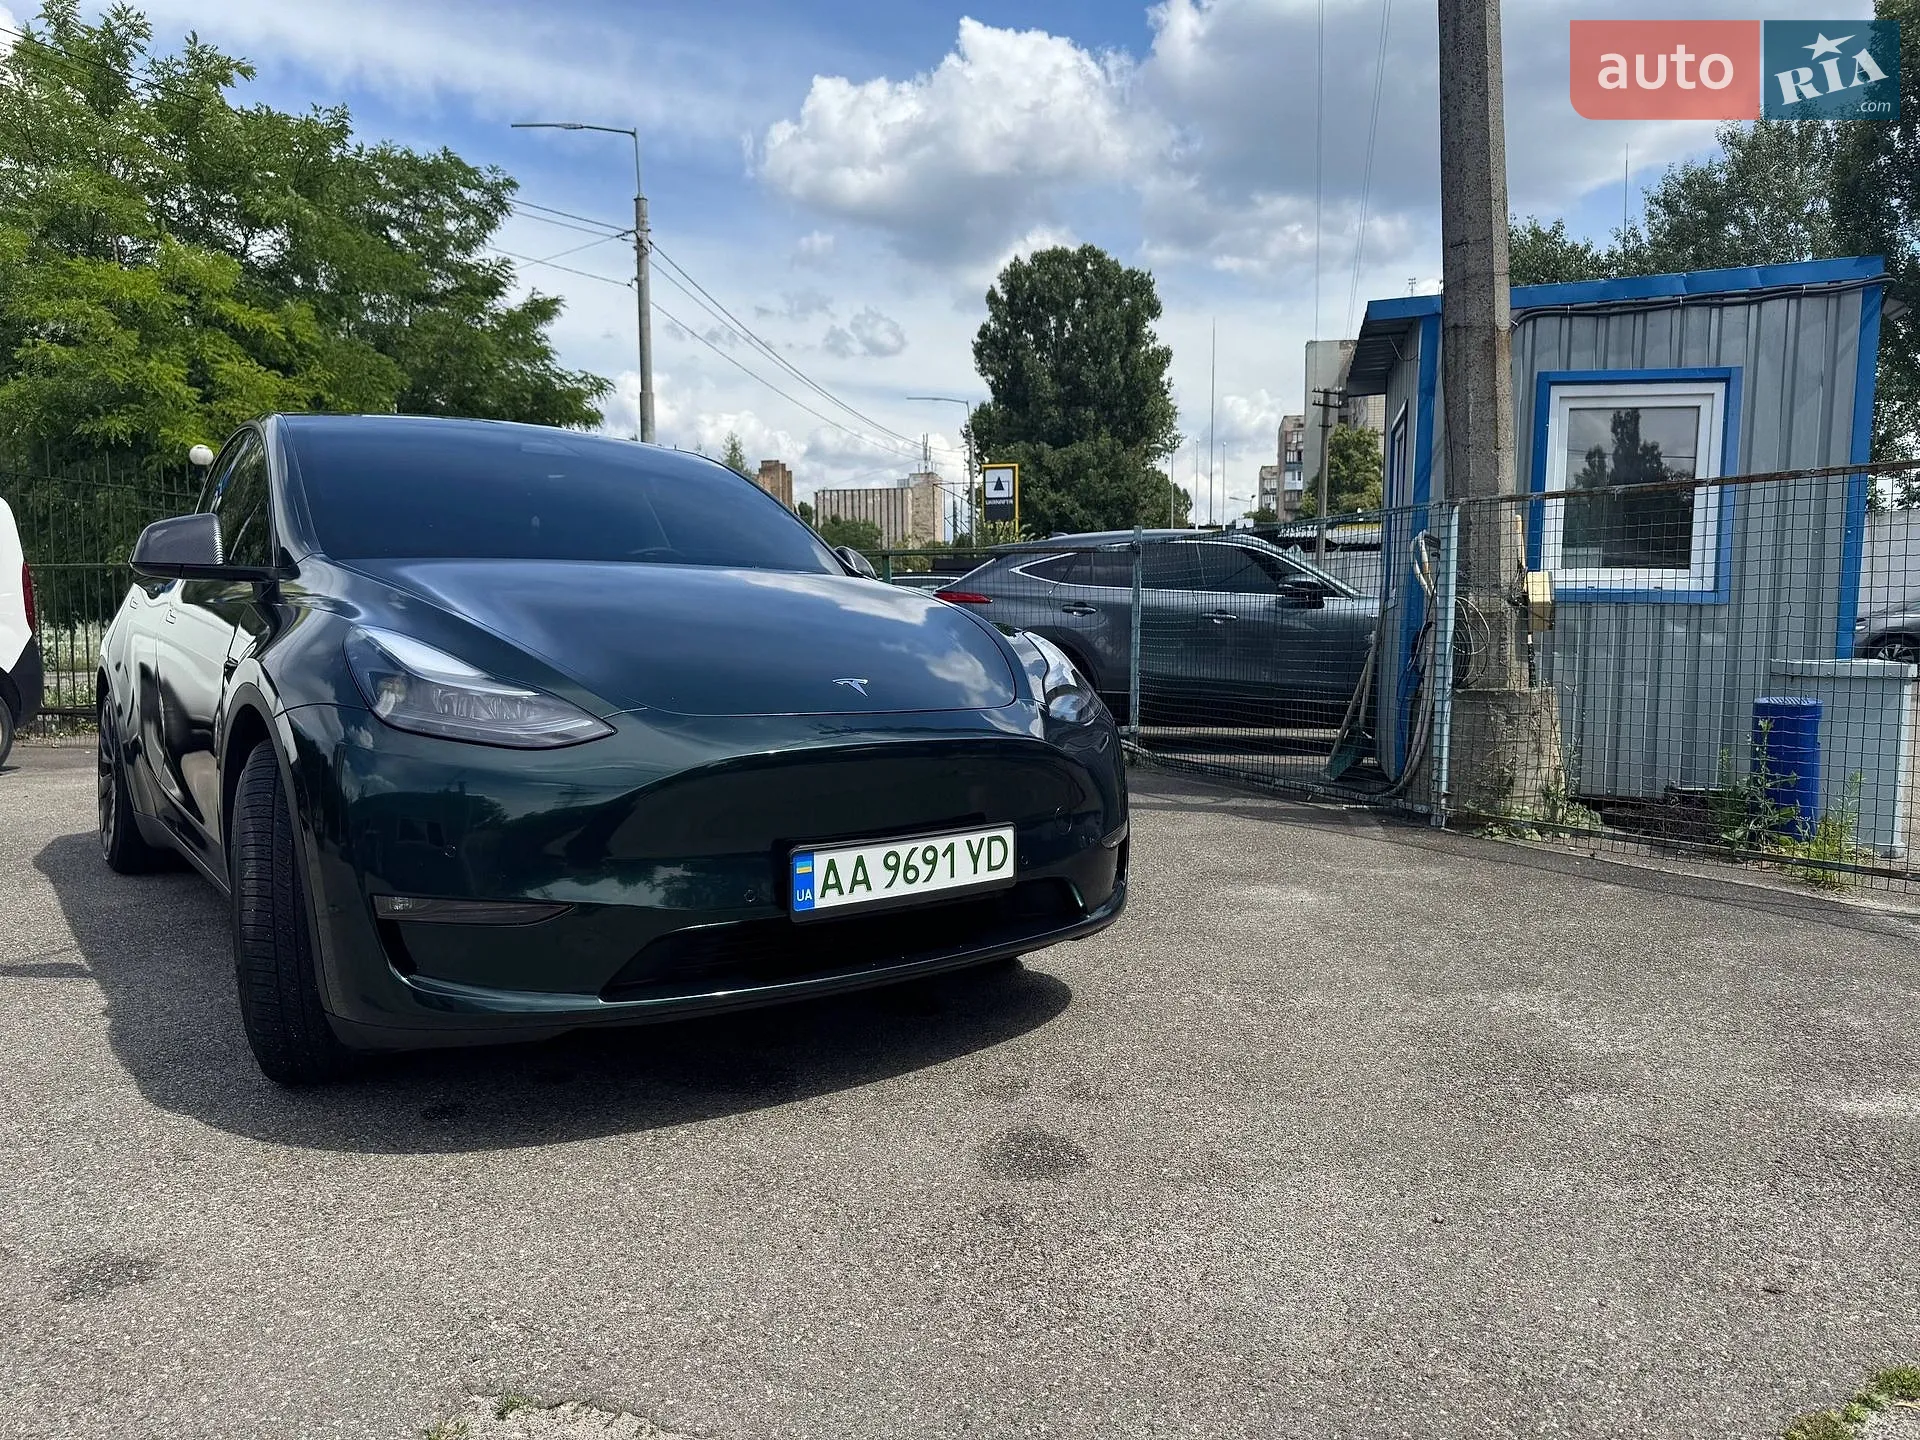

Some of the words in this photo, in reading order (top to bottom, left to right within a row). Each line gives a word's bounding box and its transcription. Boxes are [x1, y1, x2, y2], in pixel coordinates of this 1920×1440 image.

[819, 855, 873, 898] AA
[883, 842, 956, 889] 9691
[966, 835, 1009, 875] YD
[796, 889, 813, 902] UA
